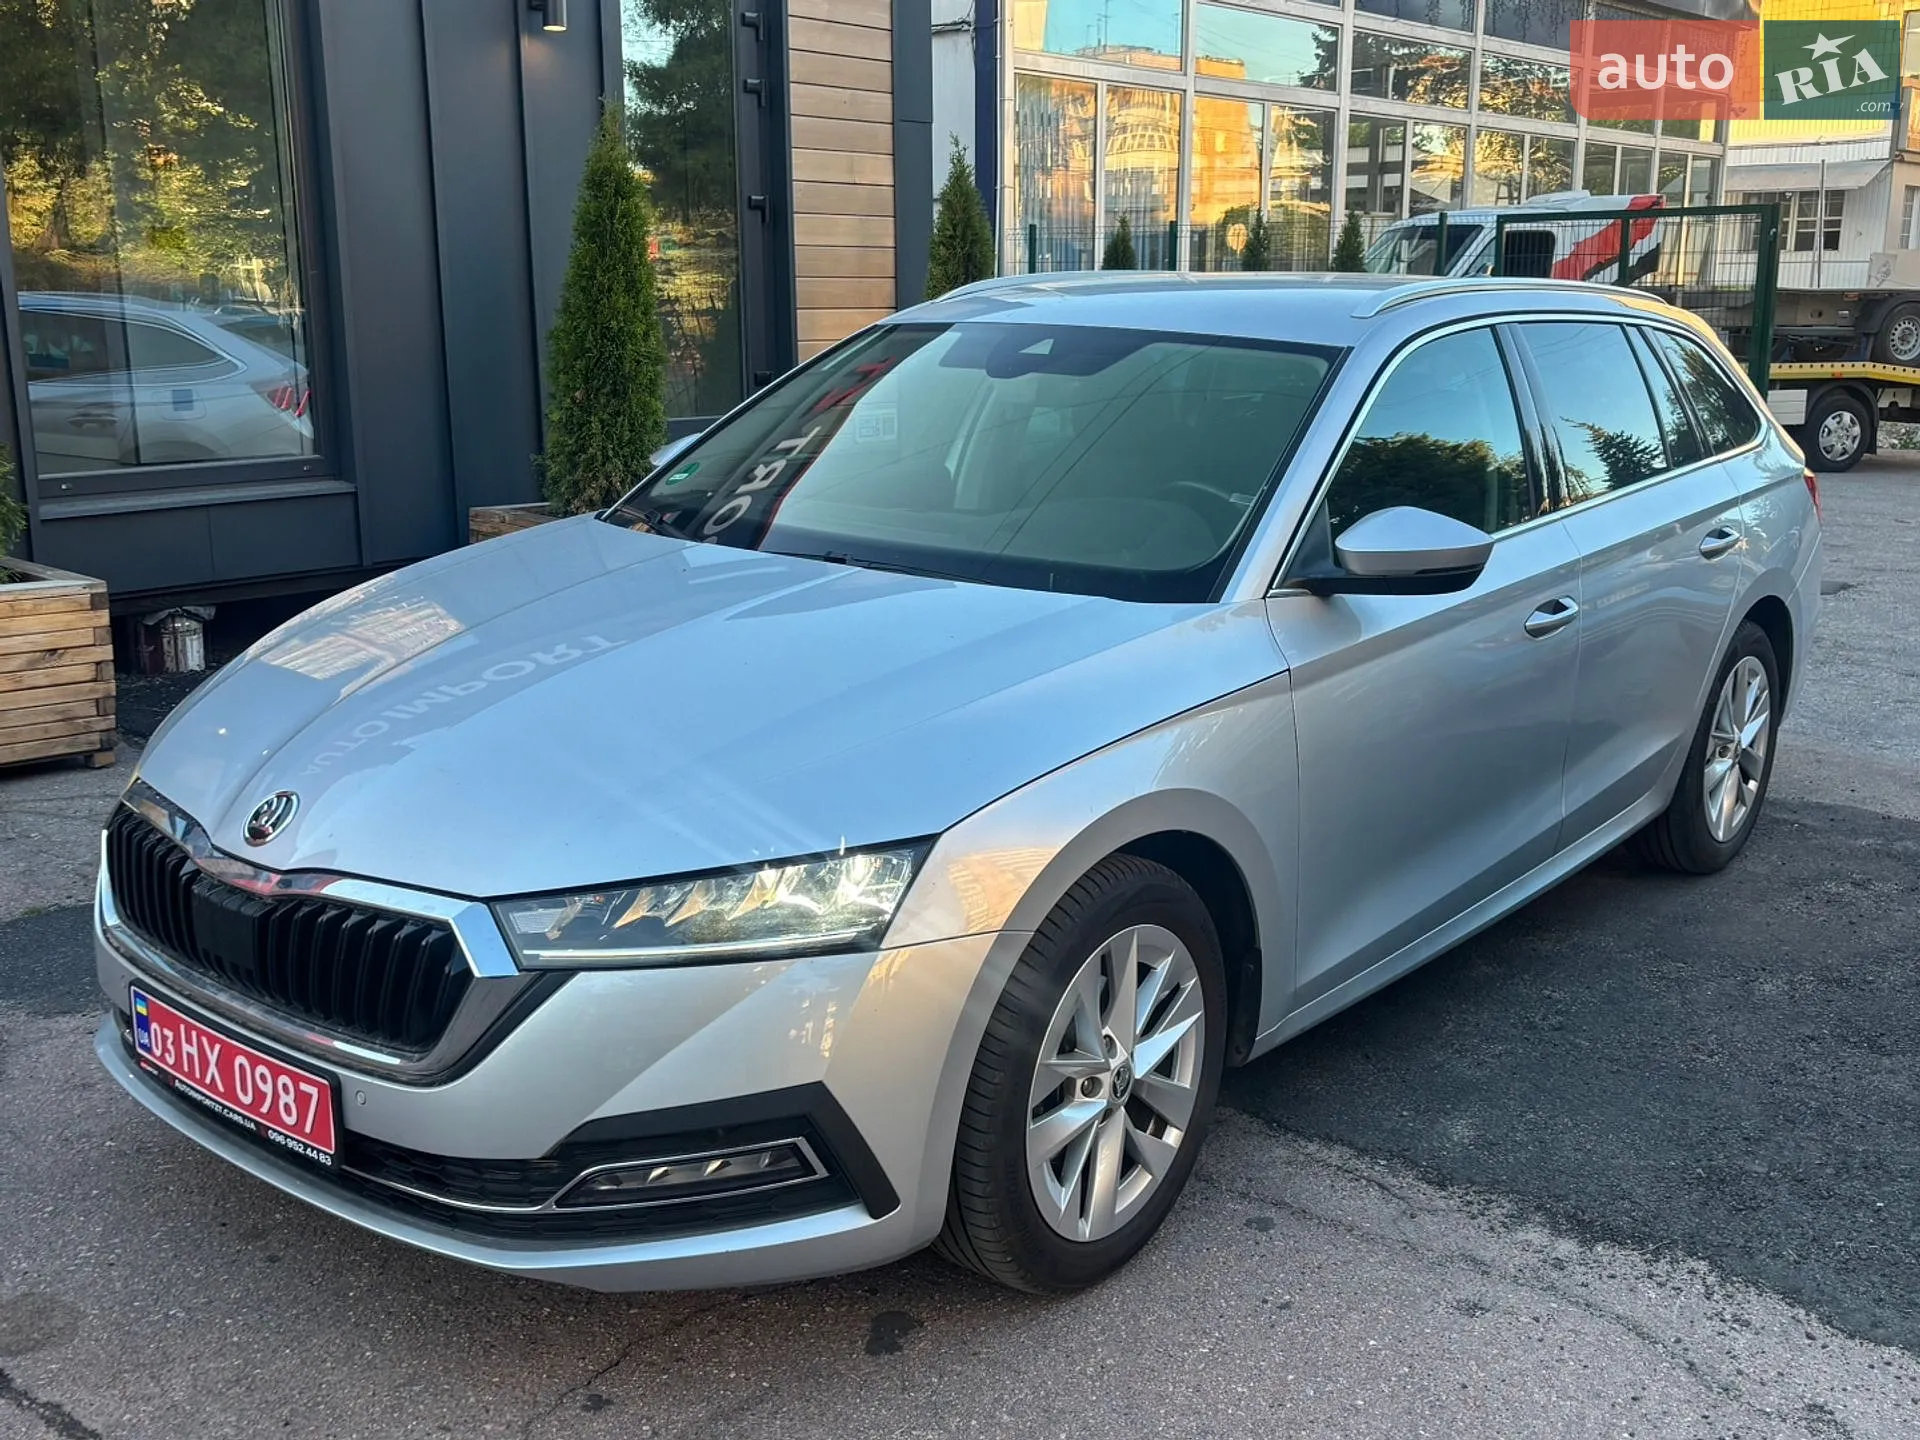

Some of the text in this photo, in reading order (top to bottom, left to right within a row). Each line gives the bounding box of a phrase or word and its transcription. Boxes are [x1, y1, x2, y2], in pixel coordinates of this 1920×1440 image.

[150, 1021, 319, 1134] 03 HX 0987
[286, 1138, 305, 1154] 952
[305, 1147, 318, 1160] 44
